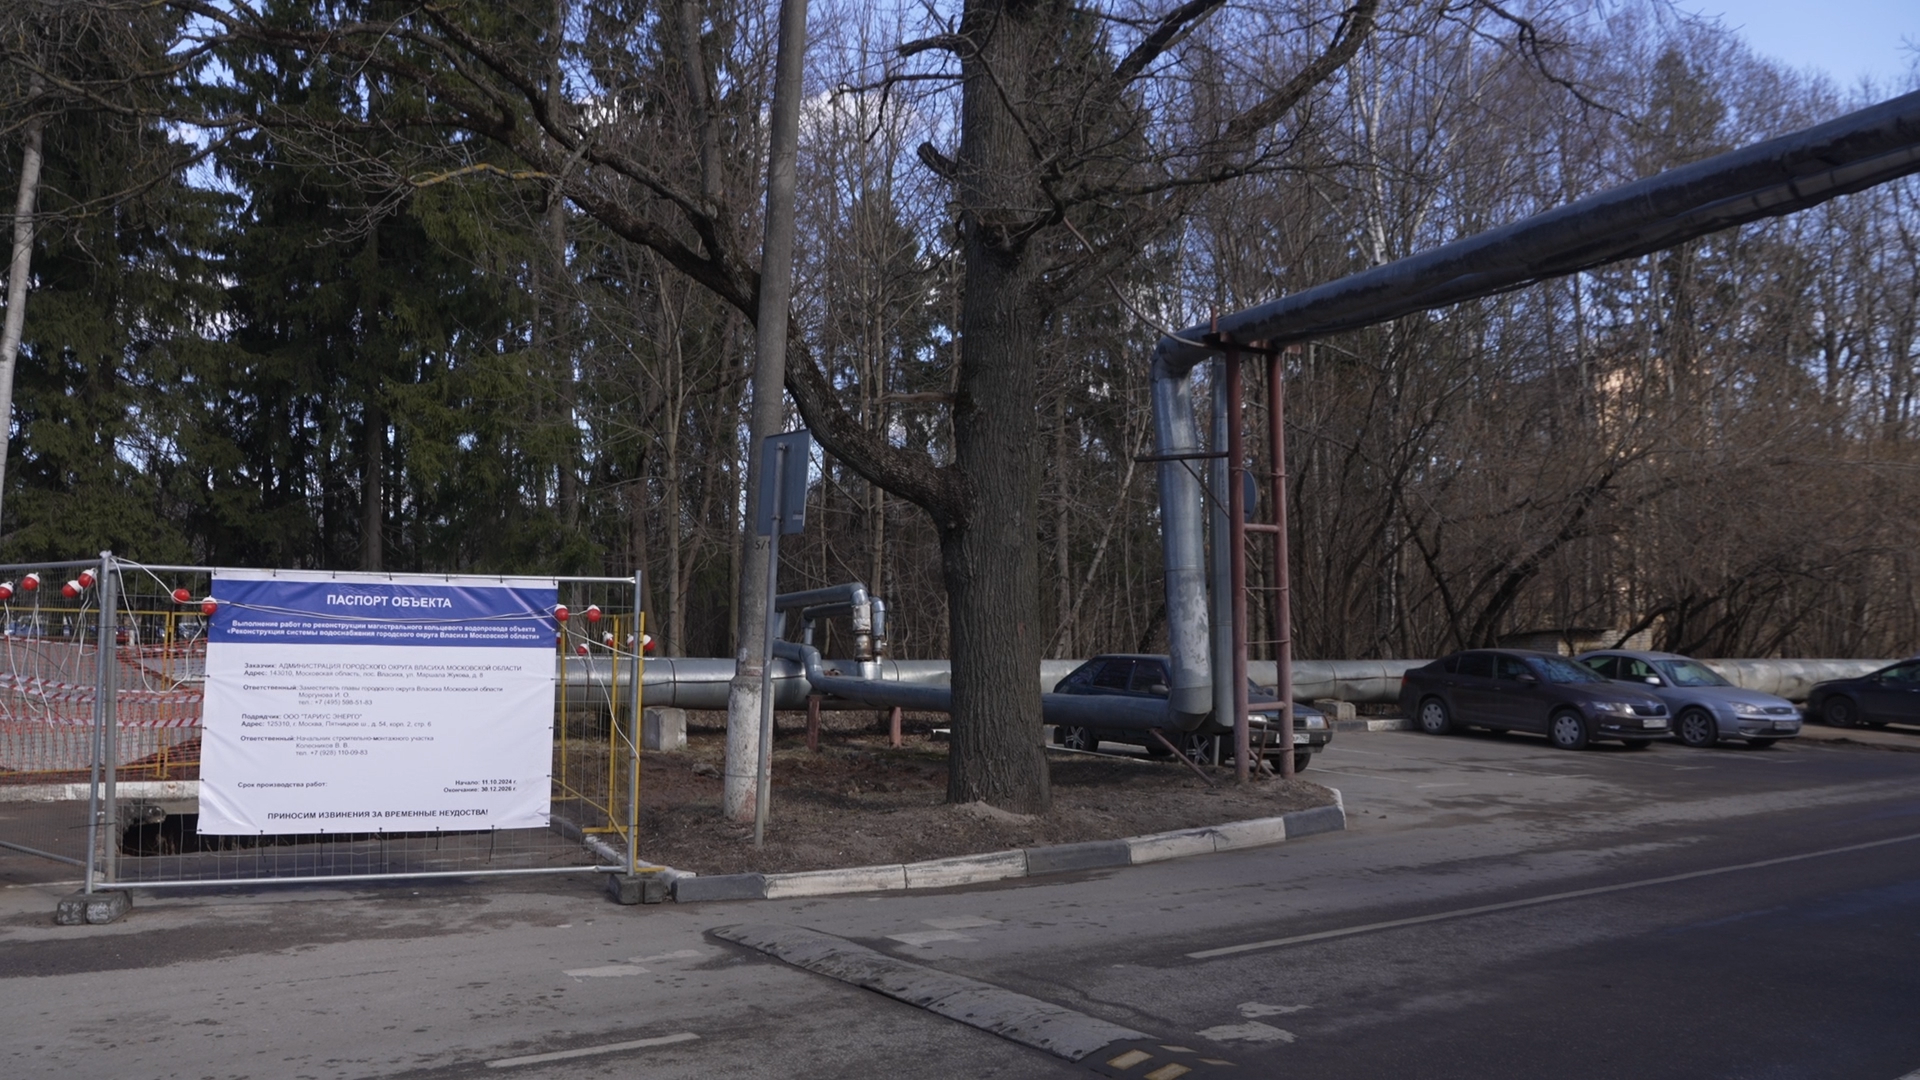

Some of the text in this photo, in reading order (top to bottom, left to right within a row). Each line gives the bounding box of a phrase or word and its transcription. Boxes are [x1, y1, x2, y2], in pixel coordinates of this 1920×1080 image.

[327, 594, 452, 608] ПАСПОРТ ОБЪЕКТА
[231, 620, 279, 629] Выполнение
[313, 623, 366, 631] реконструкции
[509, 626, 536, 634] объекта
[241, 713, 281, 721] Подрядчик:
